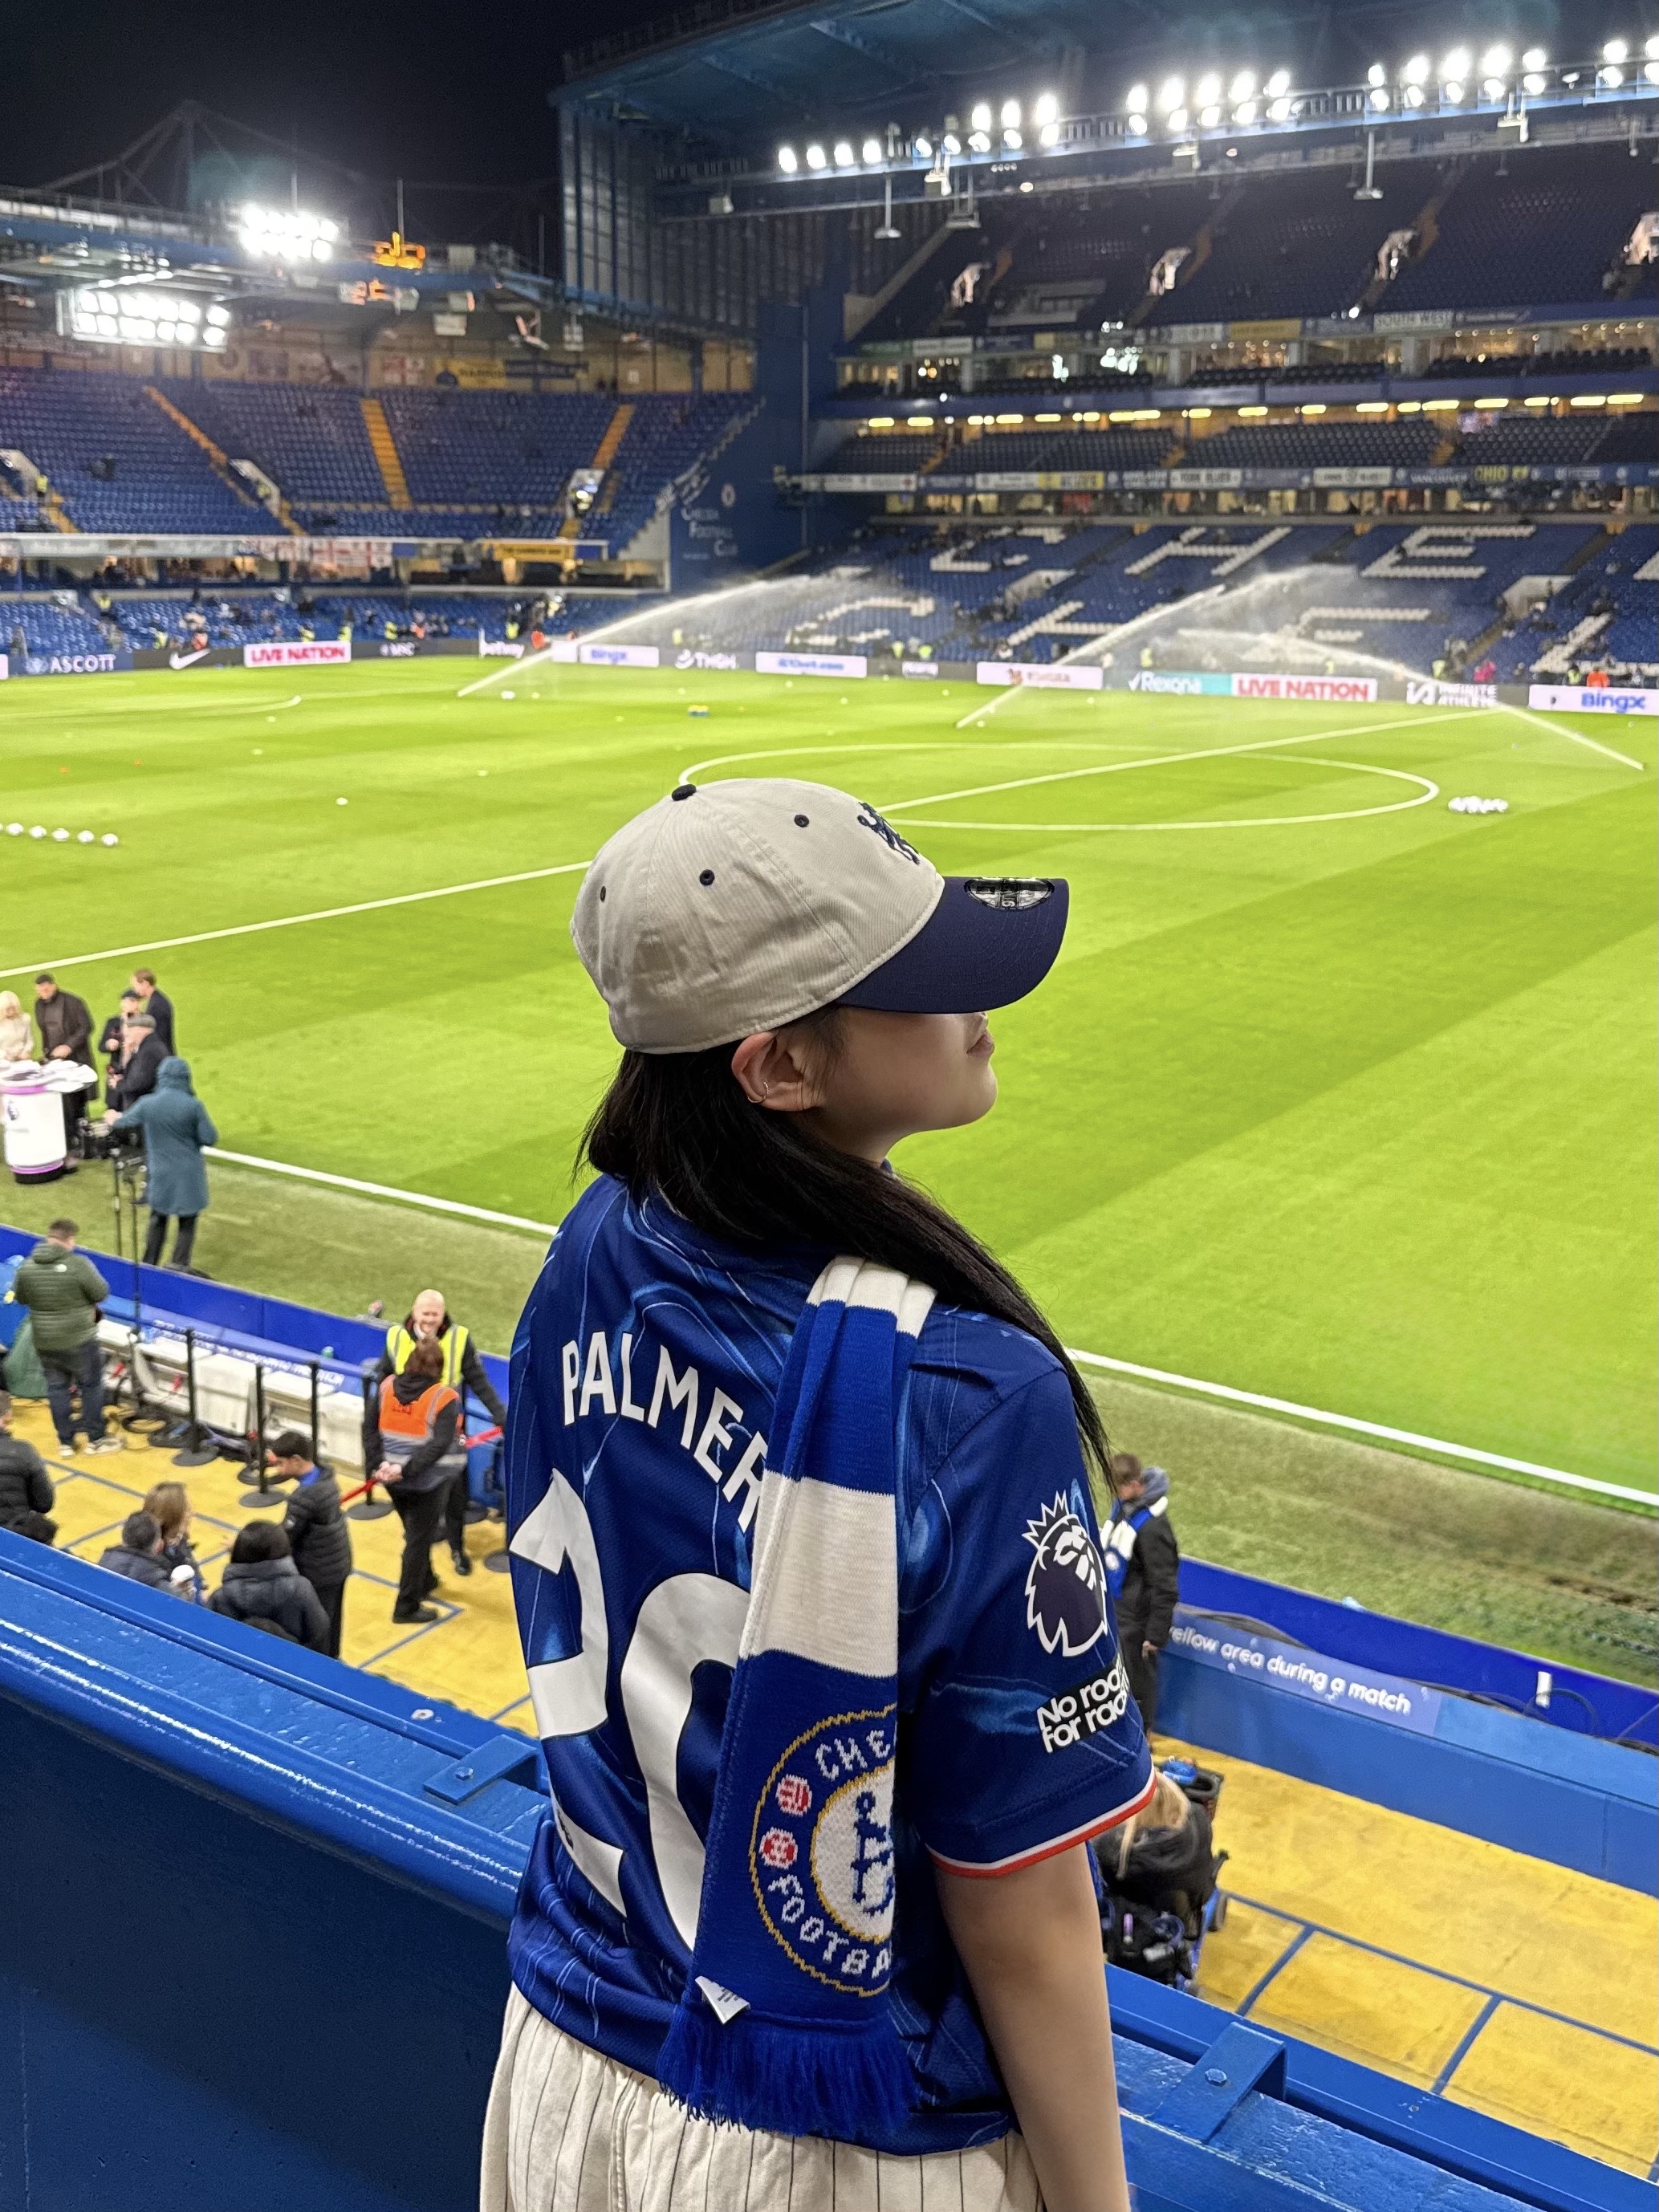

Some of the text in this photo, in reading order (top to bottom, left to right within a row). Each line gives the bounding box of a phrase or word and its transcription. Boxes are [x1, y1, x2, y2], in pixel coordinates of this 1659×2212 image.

[50, 653, 116, 673] ASCOTT
[251, 645, 346, 663] LIVE NATION
[1238, 678, 1369, 700] LIVE NATION
[1221, 1643, 1266, 1669] area
[1267, 1655, 1328, 1695] during
[1330, 1677, 1346, 1696] a
[1348, 1682, 1411, 1715] match
[1037, 1695, 1077, 1730] No
[1043, 1716, 1081, 1753] for
